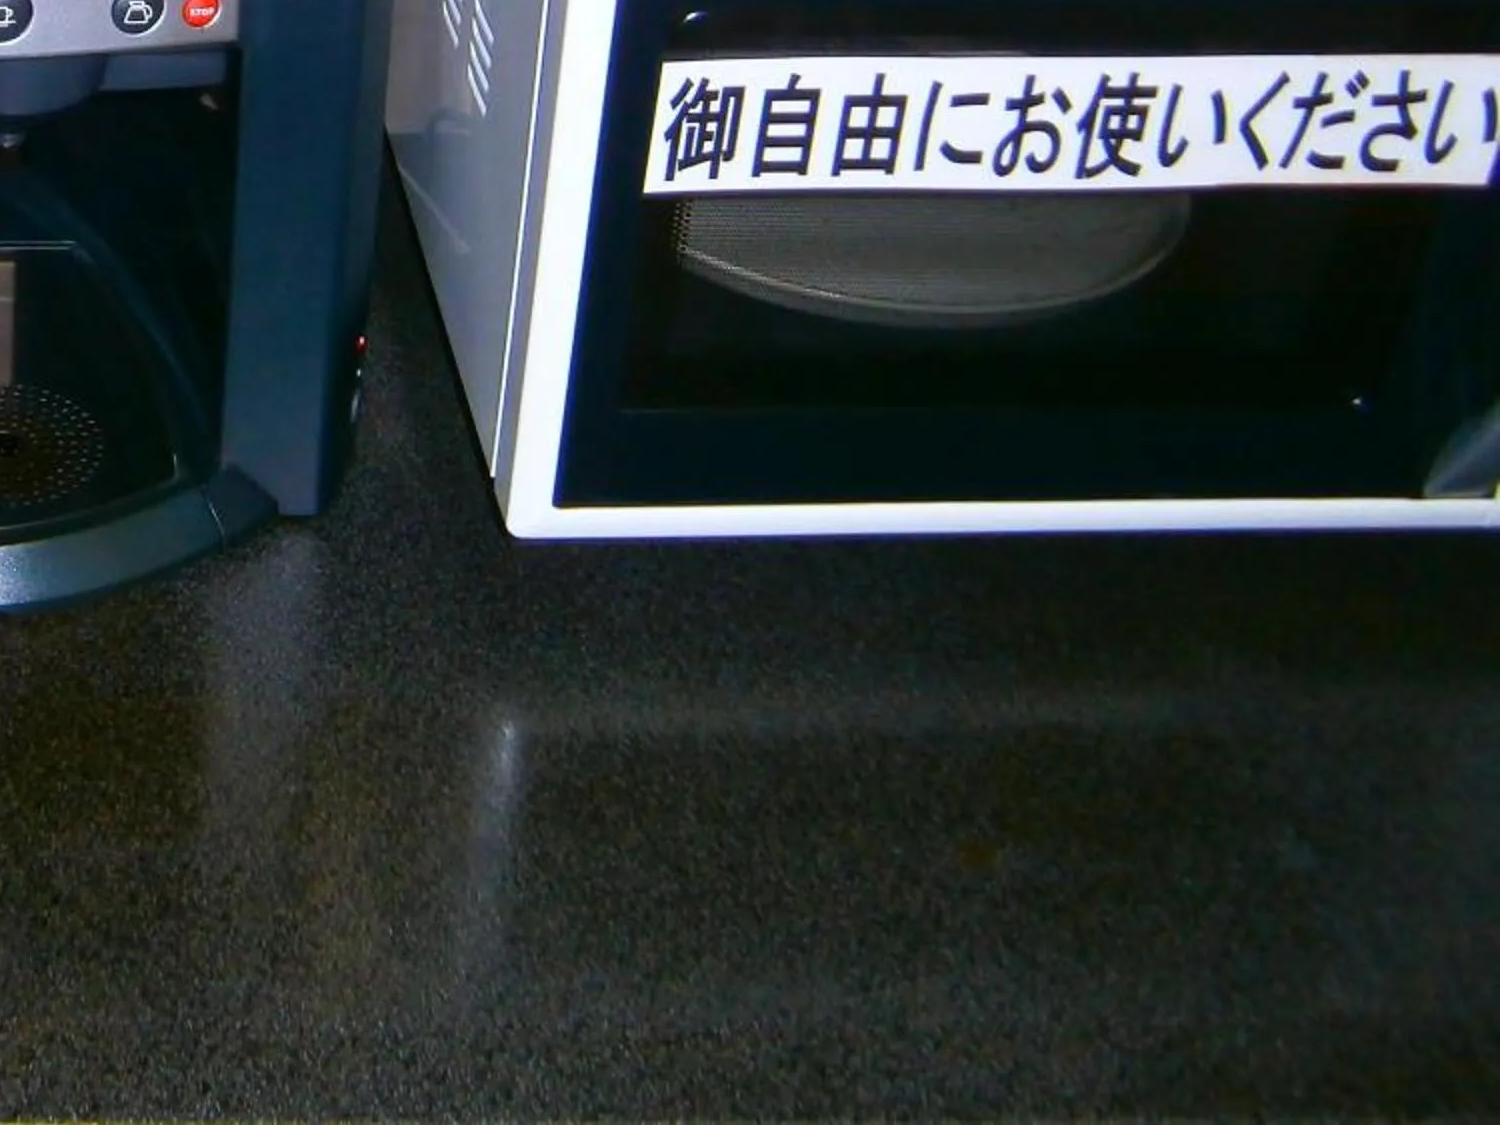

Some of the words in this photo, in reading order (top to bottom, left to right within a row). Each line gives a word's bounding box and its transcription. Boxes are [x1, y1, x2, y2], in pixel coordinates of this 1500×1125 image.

[662, 68, 1499, 182] 御自由にお使いください
